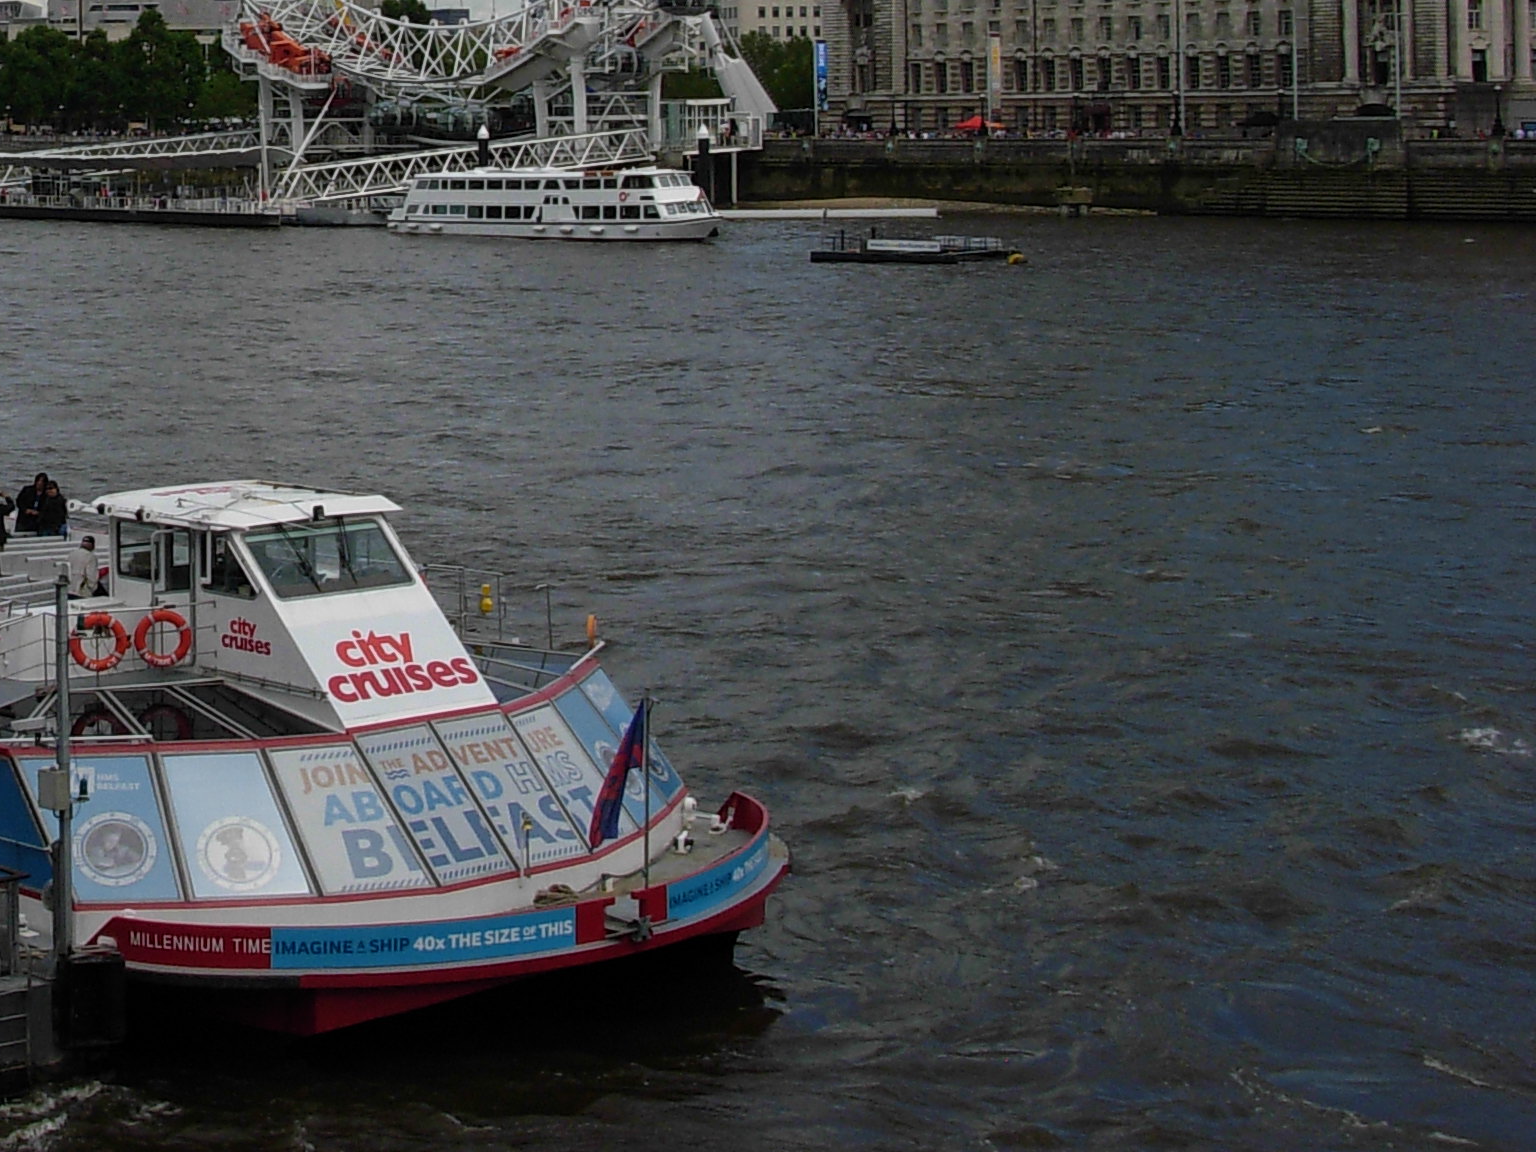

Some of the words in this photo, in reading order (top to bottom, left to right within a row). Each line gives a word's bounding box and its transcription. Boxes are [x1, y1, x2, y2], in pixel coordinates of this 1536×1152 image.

[221, 633, 272, 656] cruises
[229, 616, 257, 637] city
[335, 629, 413, 667] city
[327, 657, 478, 703] cruises
[299, 761, 371, 795] JOIN
[379, 756, 404, 771] THE
[411, 725, 564, 775] ADVENTURE
[323, 770, 505, 827] ABOARD
[505, 750, 584, 795] HMS
[341, 785, 595, 880] BELFAST
[129, 930, 225, 954] MILLENNIUM
[232, 936, 272, 954] TIME
[274, 939, 354, 956] IMAGINE
[369, 937, 410, 953] SHIP
[413, 935, 445, 952] 40x
[448, 931, 482, 949] THE
[484, 927, 520, 946] SIZE
[538, 919, 574, 939] THIS
